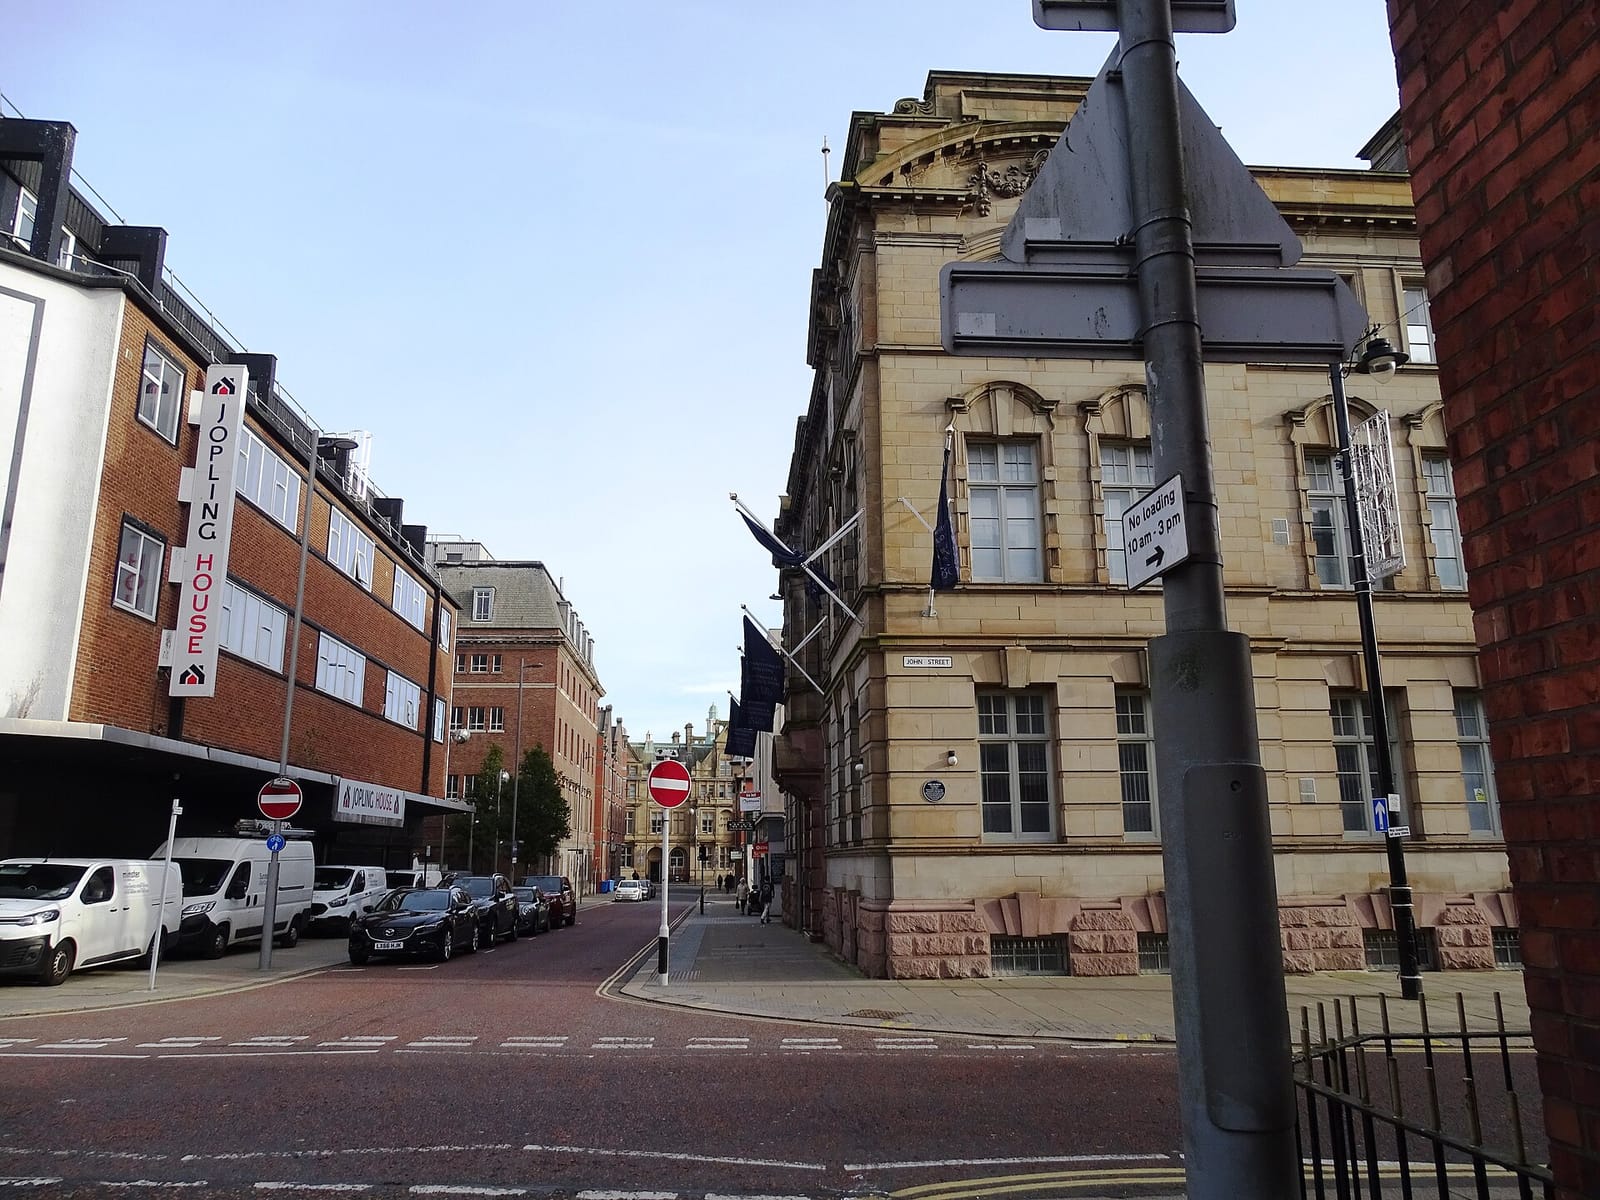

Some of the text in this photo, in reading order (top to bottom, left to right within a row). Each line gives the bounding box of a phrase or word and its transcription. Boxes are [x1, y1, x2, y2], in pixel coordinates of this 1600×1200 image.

[187, 403, 228, 654] JOPLING HOUSE
[1128, 490, 1175, 531] No loading
[1128, 538, 1138, 555] 10
[1139, 531, 1152, 548] am
[1157, 519, 1165, 536] 3
[1166, 512, 1181, 534] pm
[352, 787, 393, 811] JOPLING HOUSE
